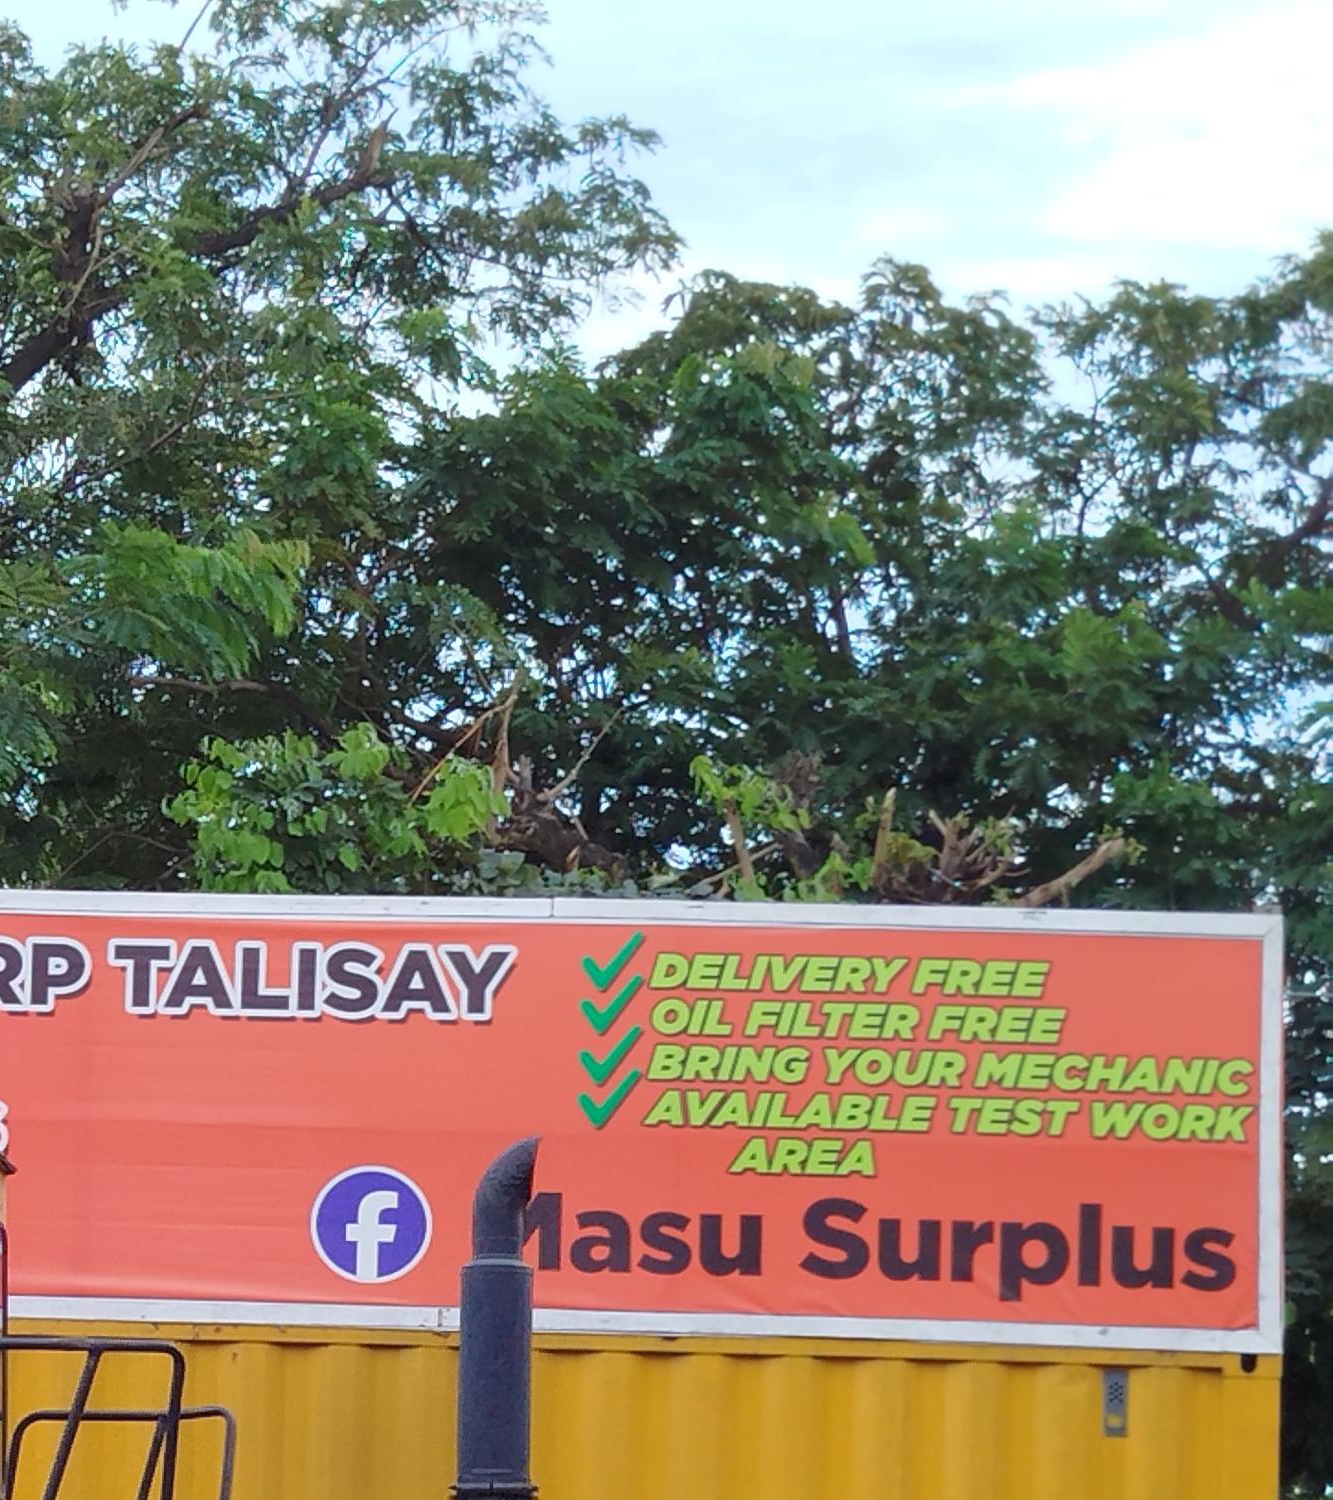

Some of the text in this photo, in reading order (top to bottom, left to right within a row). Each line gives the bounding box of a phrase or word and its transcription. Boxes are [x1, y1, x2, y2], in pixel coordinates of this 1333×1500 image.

[112, 941, 513, 1014] TALISAY
[647, 952, 1050, 998] DELIVERY FREE
[649, 998, 1067, 1045] OIL FILTER FREE
[645, 1045, 1254, 1098] BRING YOUR MECHANIC
[641, 1090, 1254, 1143] AVAILABLE TEST WORK
[727, 1138, 878, 1177] AREA
[798, 1196, 1237, 1303] Surplus
